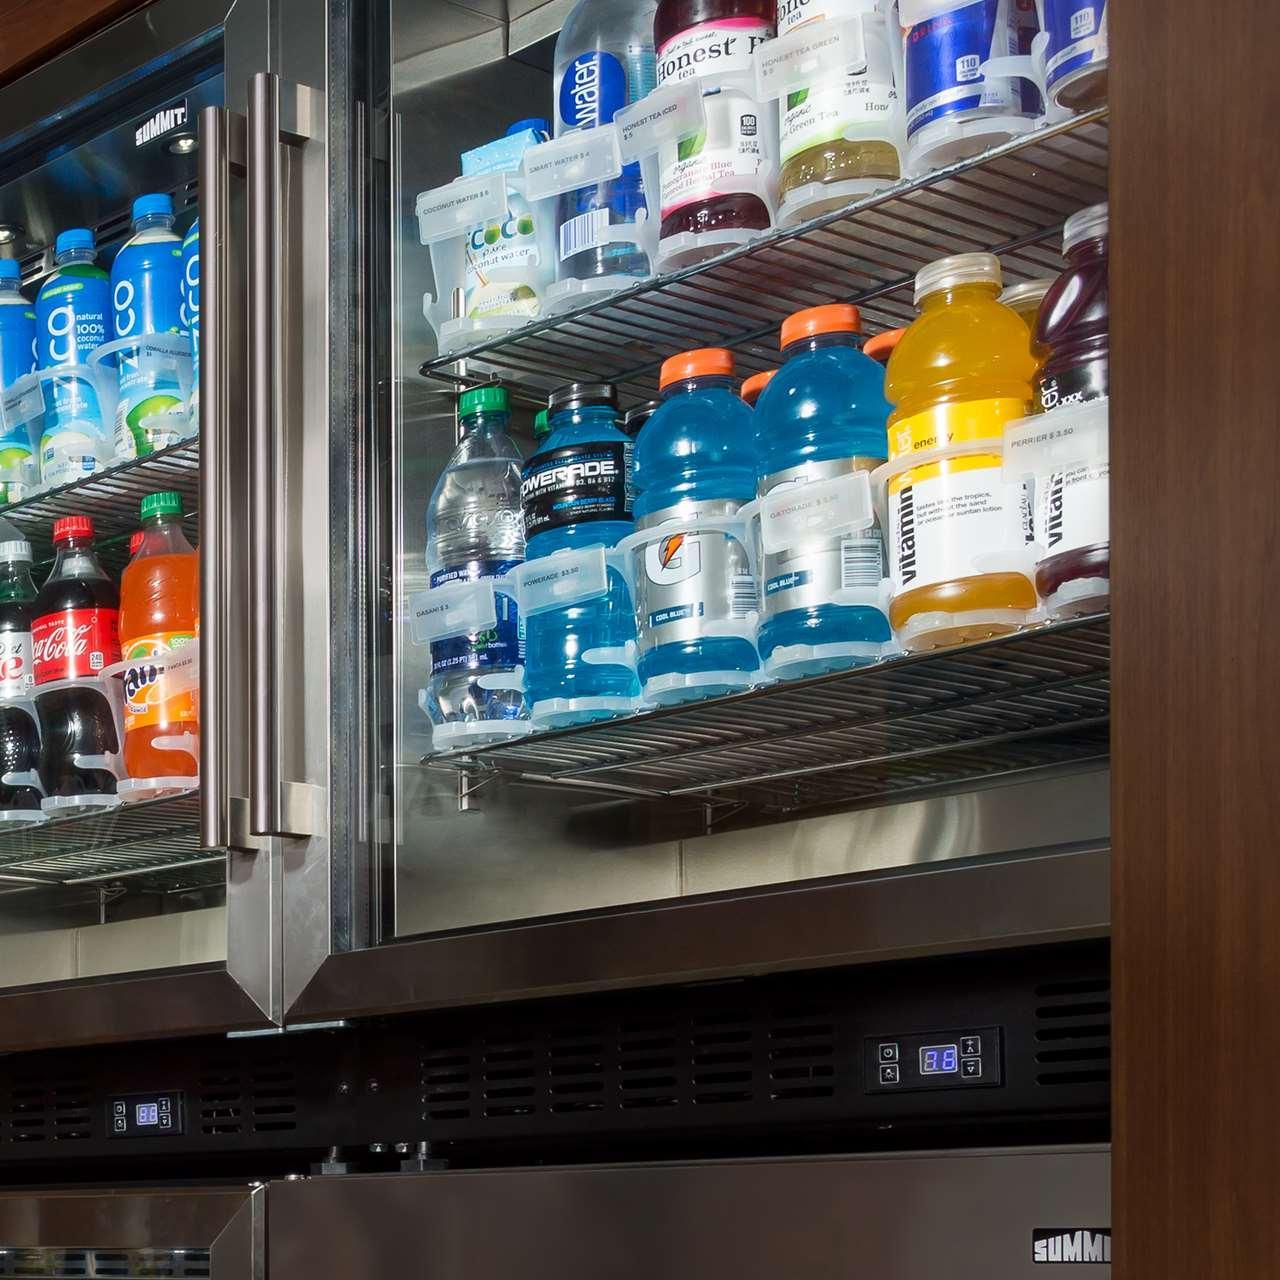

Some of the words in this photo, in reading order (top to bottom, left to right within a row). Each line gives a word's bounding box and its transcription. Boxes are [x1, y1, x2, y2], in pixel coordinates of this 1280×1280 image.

[762, 51, 794, 68] HONEST
[795, 46, 811, 57] TEA
[812, 35, 840, 50] GREEN
[657, 37, 737, 85] Honest
[678, 68, 695, 80] tea
[135, 106, 186, 146] SUMMIT
[622, 115, 648, 134] HONEST
[648, 110, 662, 122] TEA
[662, 104, 678, 116] ICED
[553, 155, 579, 167] WATER
[423, 199, 456, 215] COCONUT
[76, 313, 103, 321] natural
[76, 324, 105, 334] 100%
[1011, 433, 1048, 449] PERRIER
[899, 485, 917, 586] vitamin
[523, 572, 559, 587] POWERADE
[416, 606, 440, 617] DASANI
